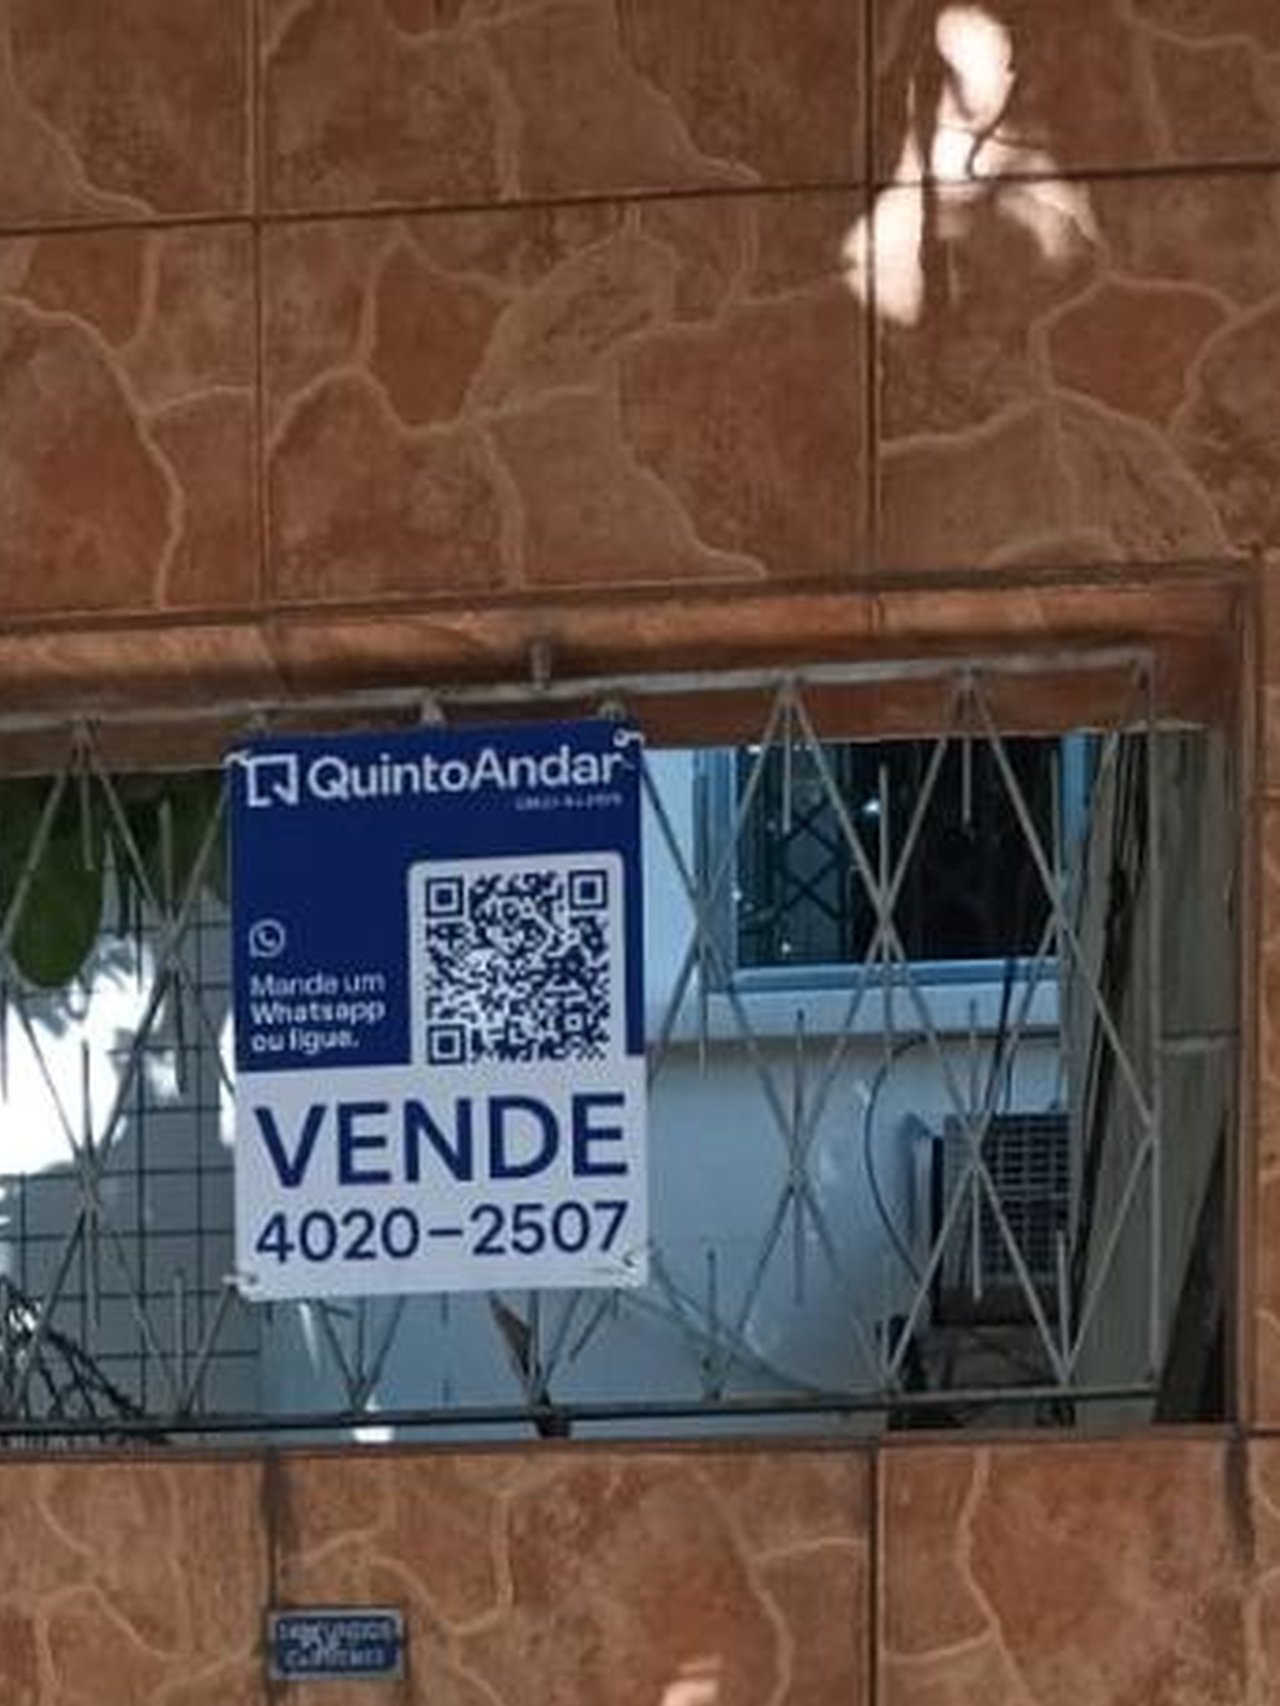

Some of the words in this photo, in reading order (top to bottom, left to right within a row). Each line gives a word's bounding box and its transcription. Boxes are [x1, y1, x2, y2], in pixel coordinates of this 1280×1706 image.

[306, 744, 623, 800] QuintoAndar
[343, 972, 386, 994] um
[249, 1000, 386, 1026] Whatsapp
[251, 1033, 285, 1051] ou
[253, 1092, 629, 1188] VENDE
[254, 1200, 629, 1264] 4020-2507
